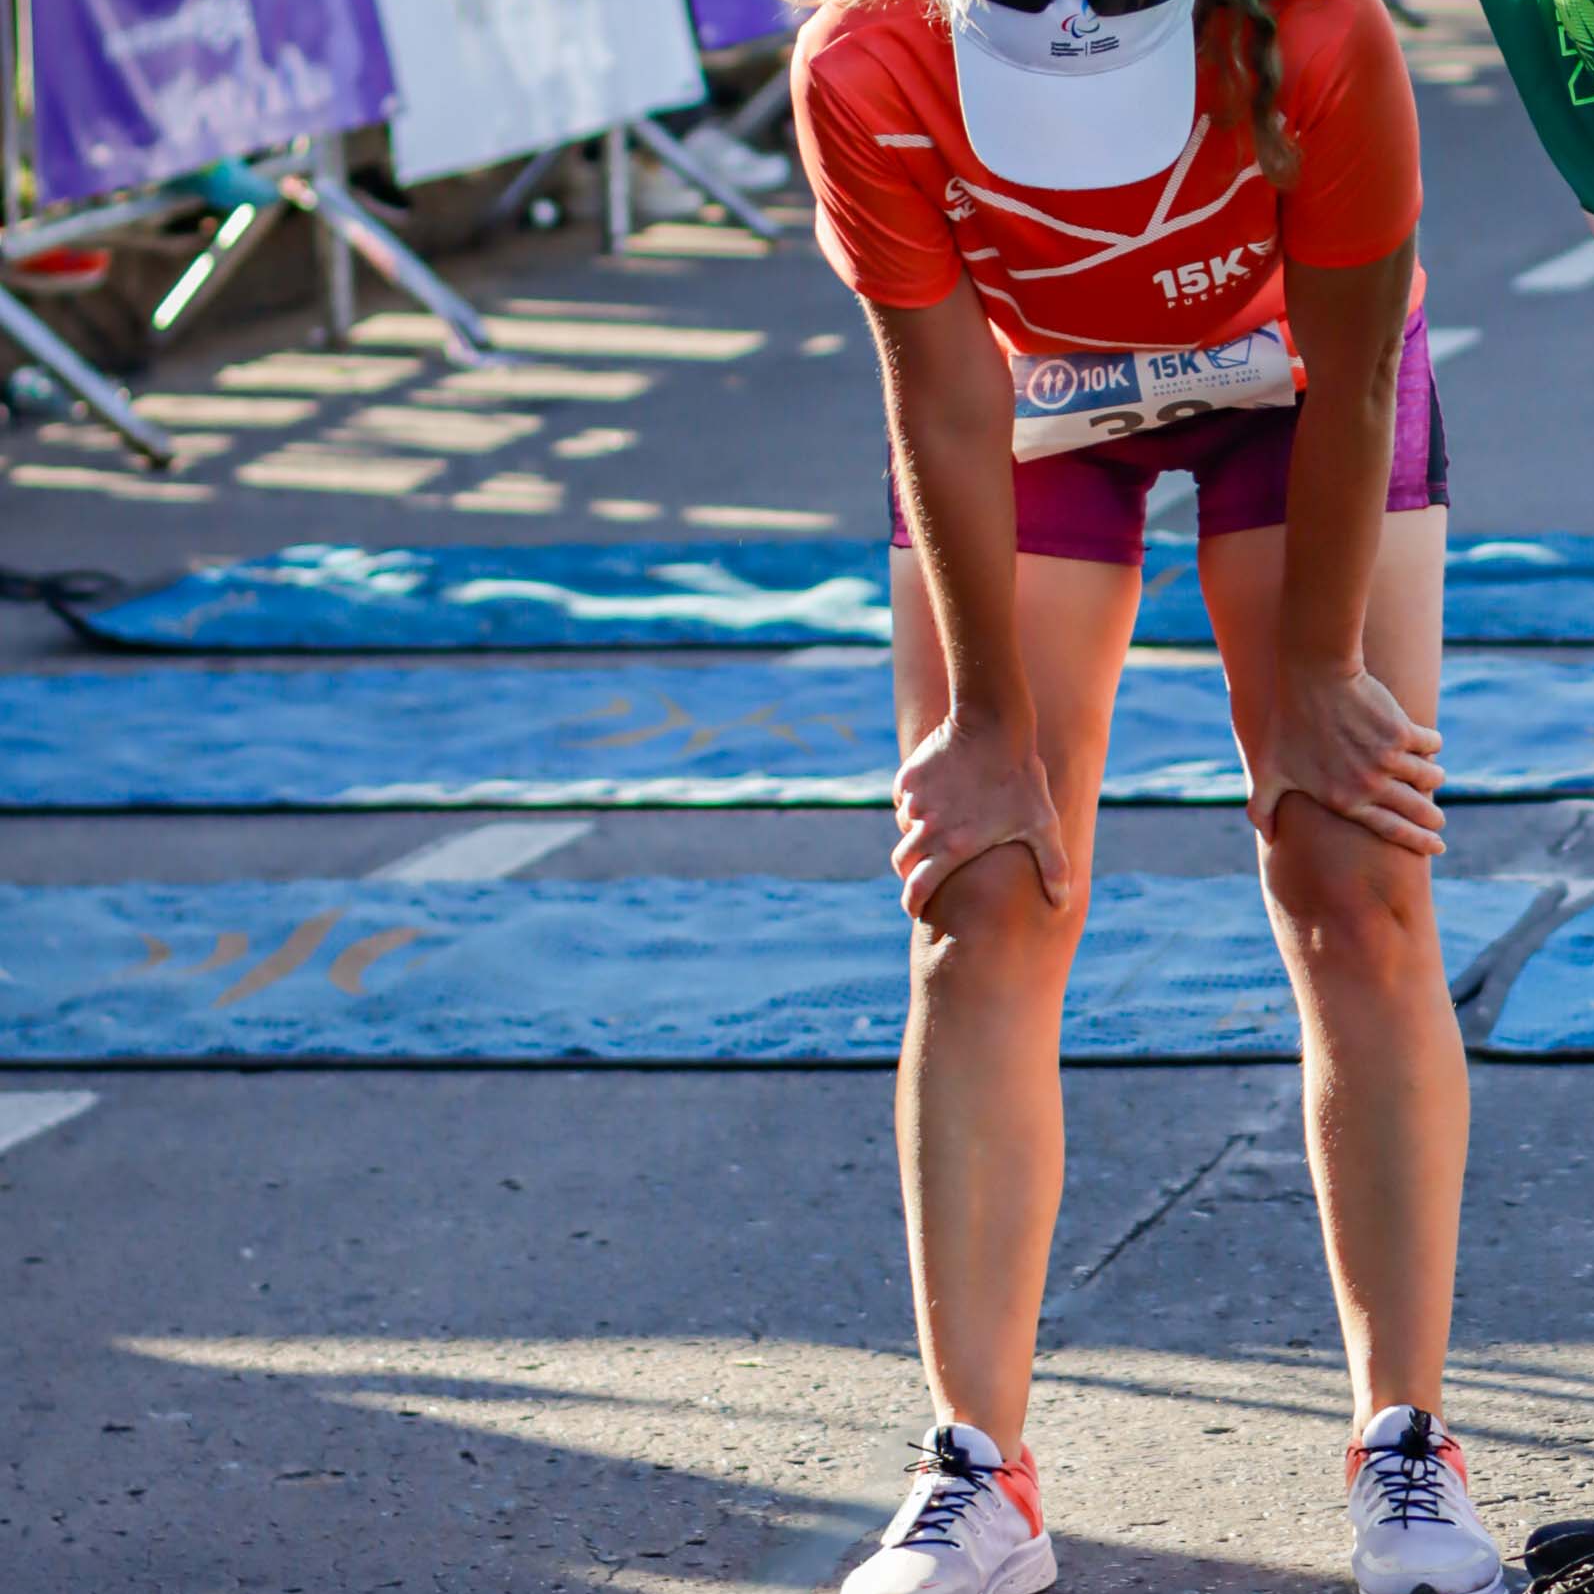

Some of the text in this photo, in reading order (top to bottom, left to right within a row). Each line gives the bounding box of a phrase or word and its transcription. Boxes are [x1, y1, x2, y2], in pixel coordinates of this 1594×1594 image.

[1152, 246, 1250, 299] 15K
[1080, 362, 1130, 392] 10K
[1147, 350, 1202, 380] 15K
